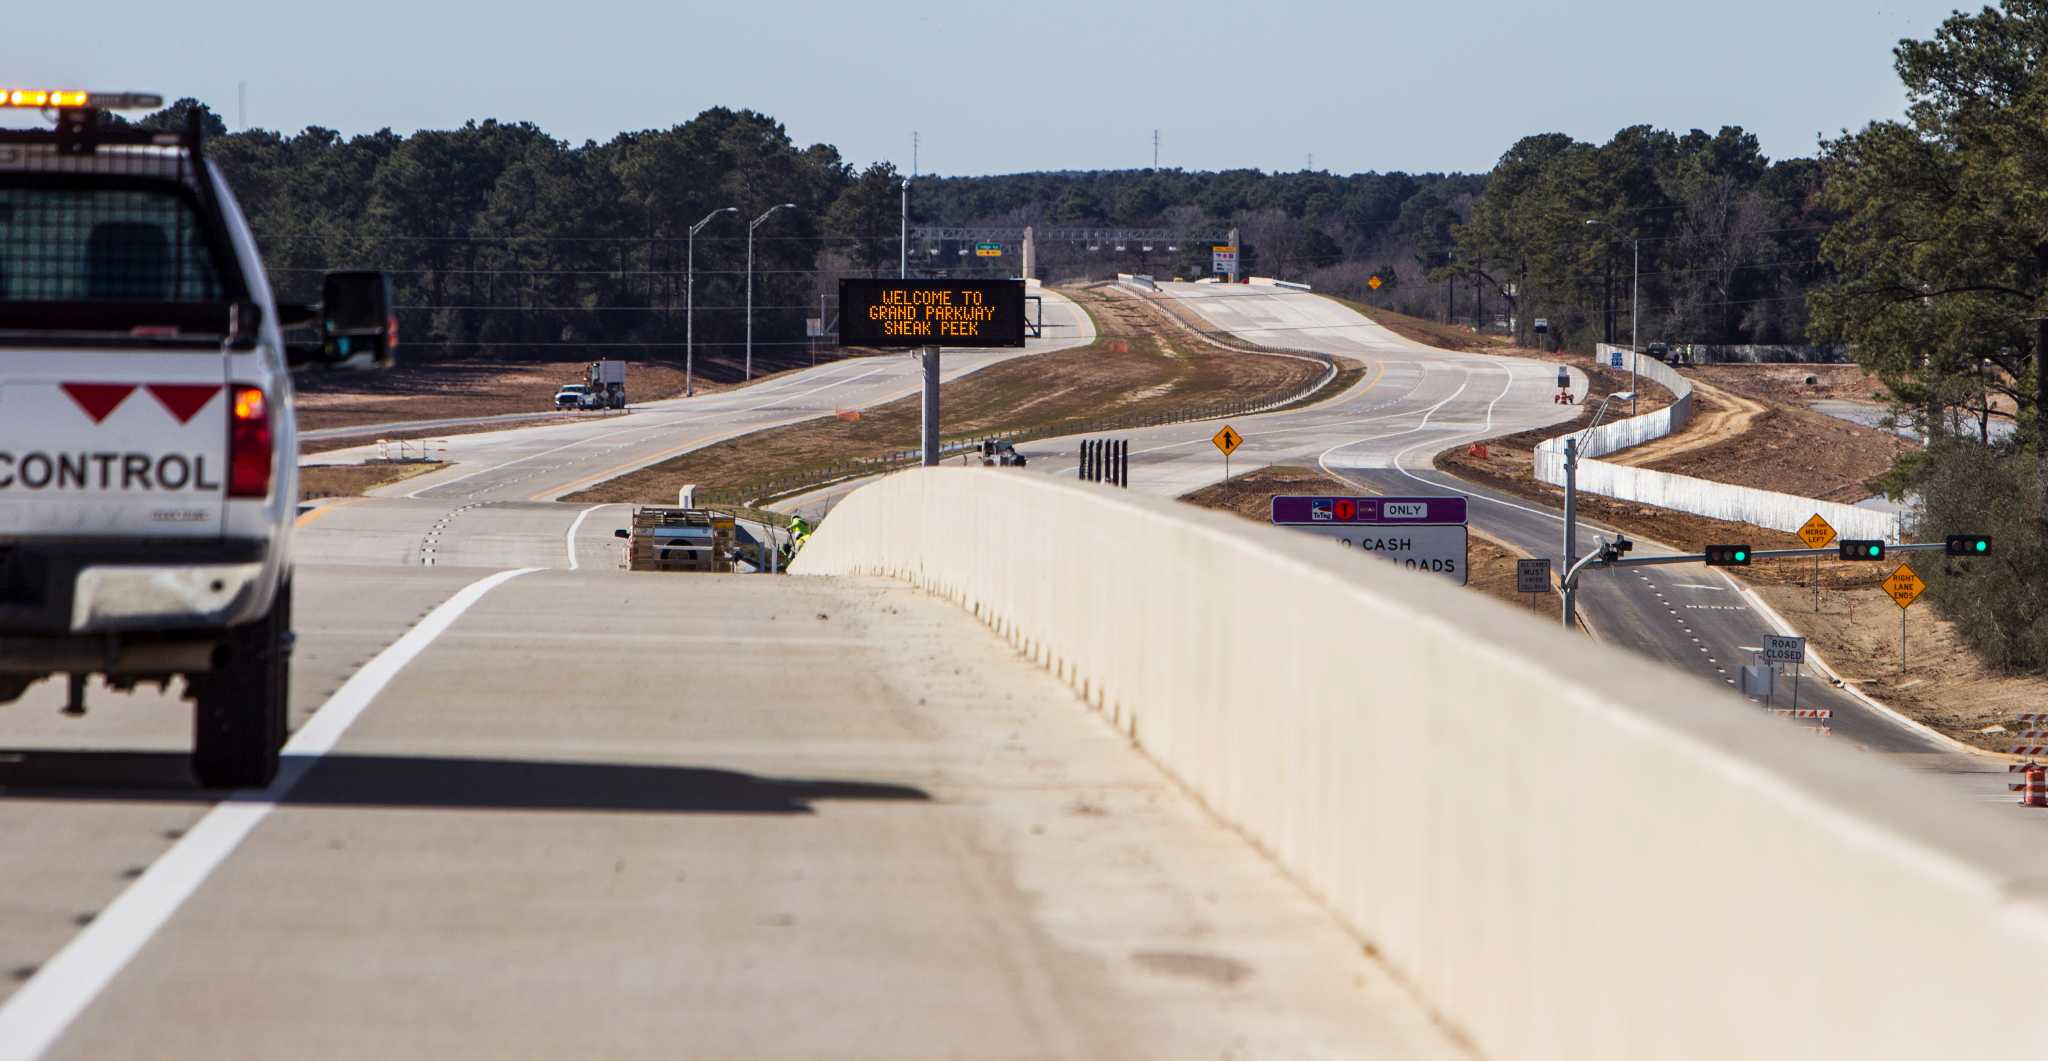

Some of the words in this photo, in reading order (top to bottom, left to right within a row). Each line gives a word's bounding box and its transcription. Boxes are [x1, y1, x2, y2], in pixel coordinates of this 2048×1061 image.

[882, 290, 952, 305] WELCOME
[961, 290, 982, 305] TO
[869, 305, 916, 321] GRAND
[925, 305, 995, 321] PARKWAY
[884, 321, 931, 336] SNEAK
[940, 321, 979, 336] PEEK
[1389, 505, 1422, 515] ONLY
[1362, 538, 1411, 551] CASH
[1894, 583, 1914, 591] LANE
[1772, 639, 1798, 649] ROAD
[1766, 649, 1802, 660] CLOSED
